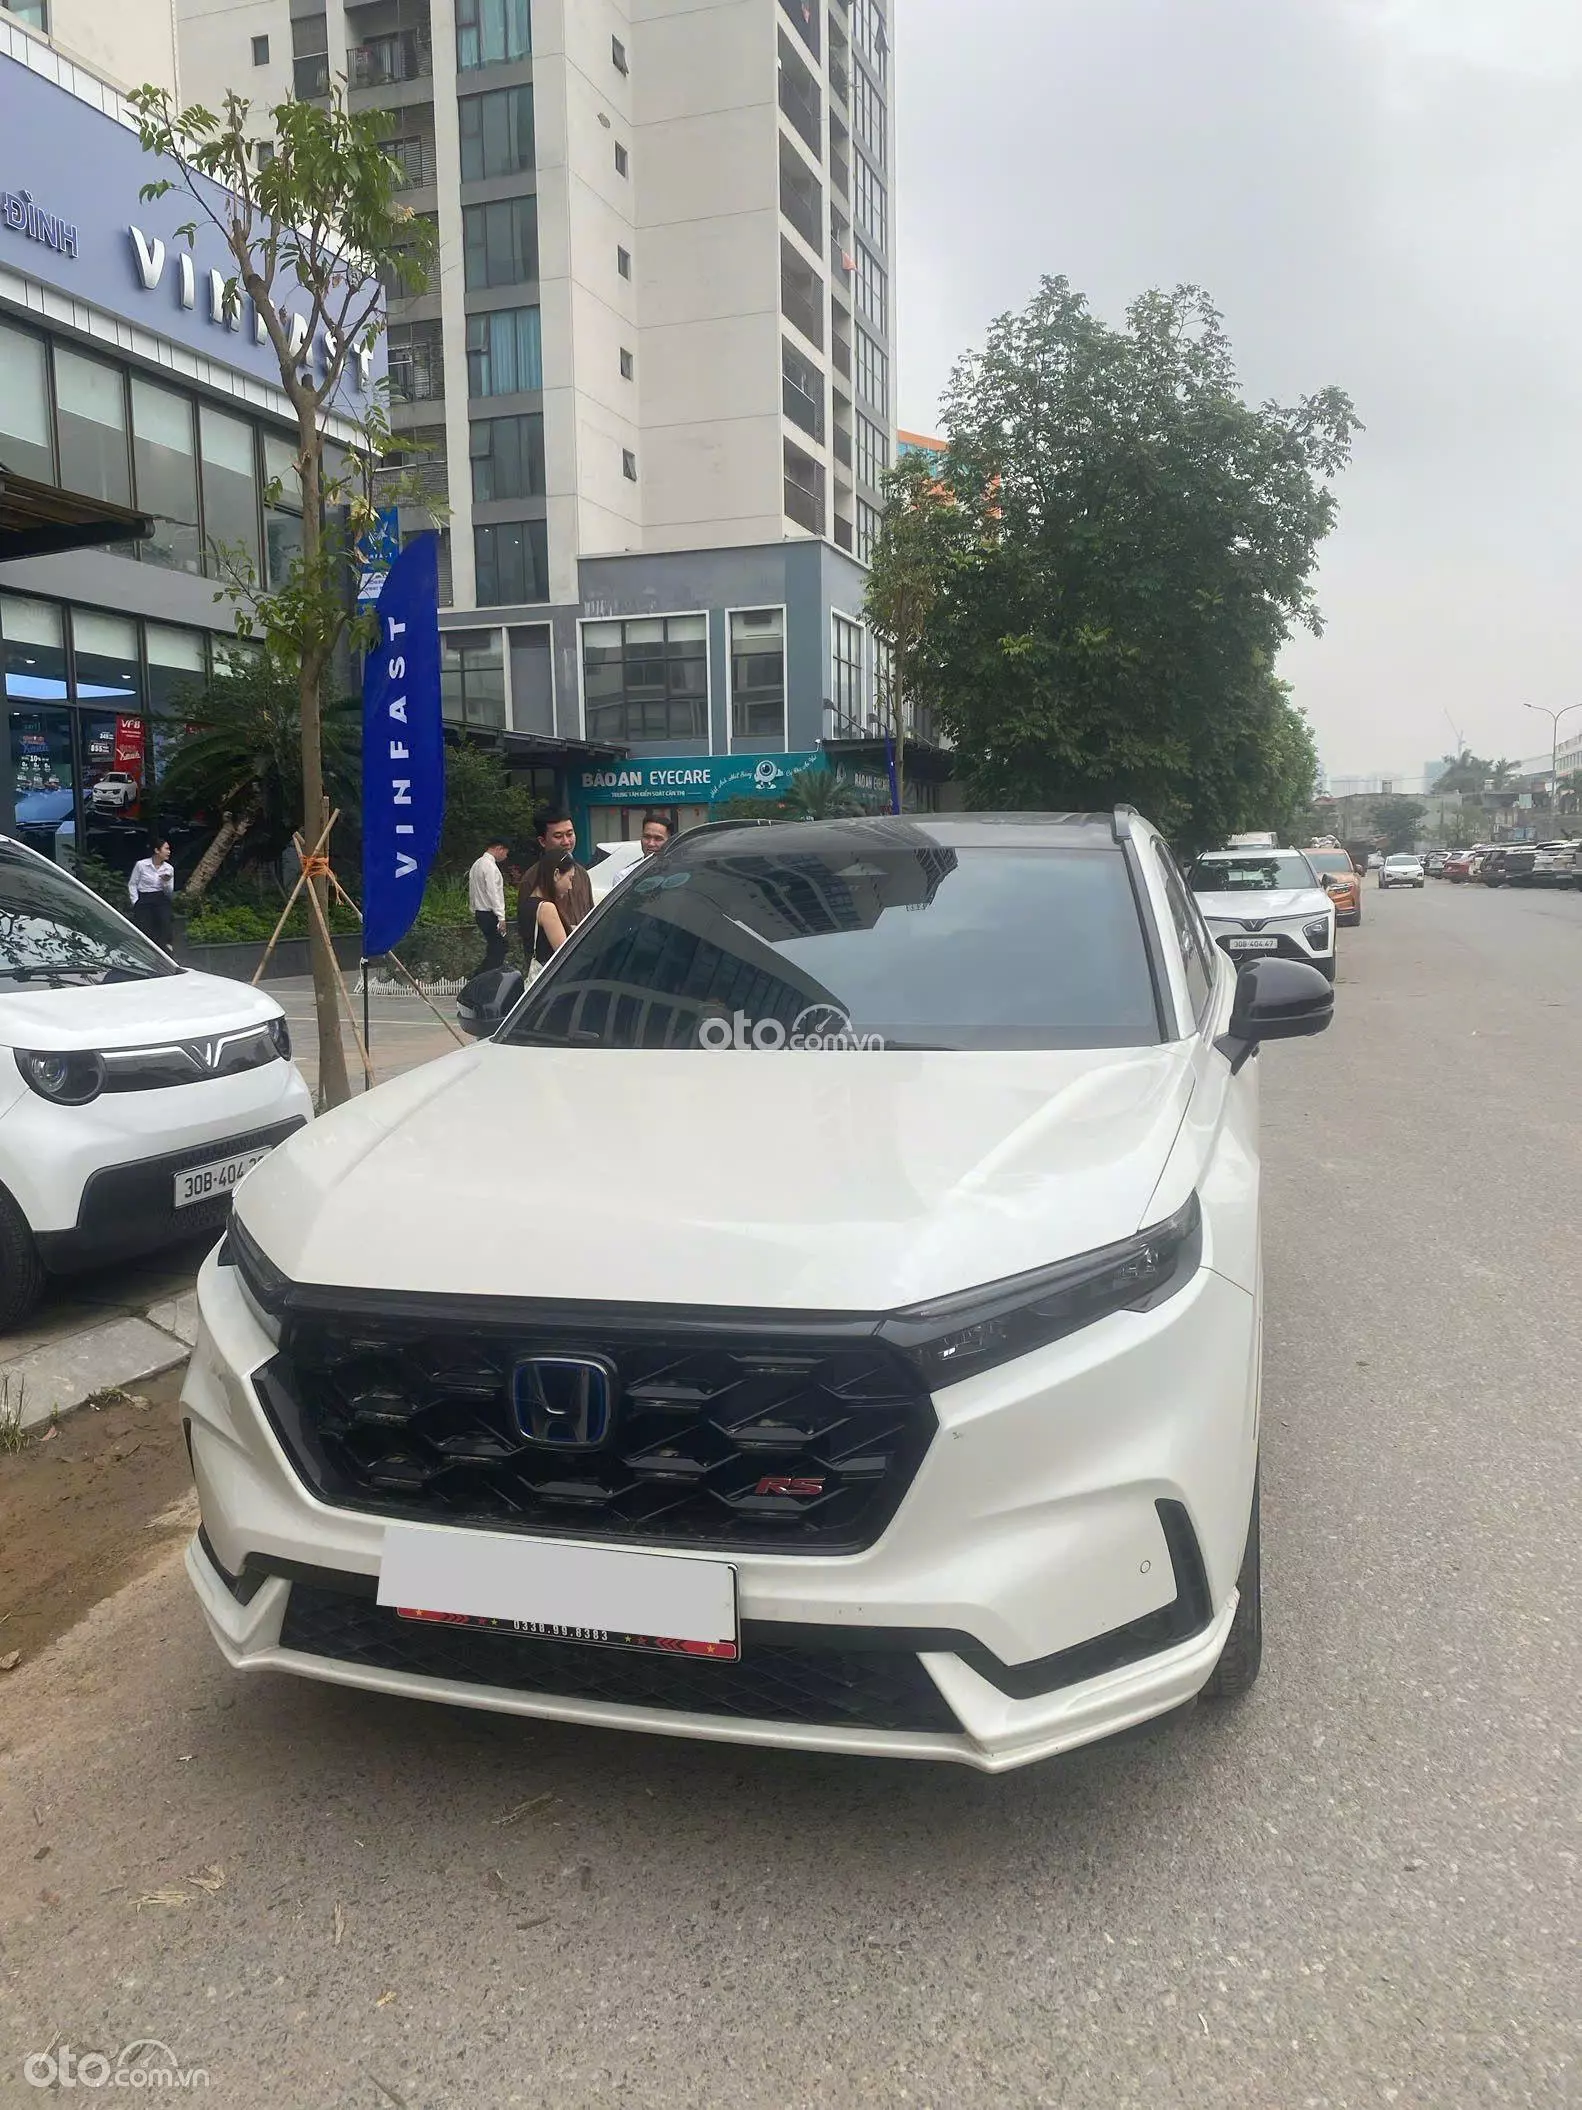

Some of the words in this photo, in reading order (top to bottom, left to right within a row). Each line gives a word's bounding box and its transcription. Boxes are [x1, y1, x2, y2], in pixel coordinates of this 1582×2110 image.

[4, 189, 79, 258] ĐÌNH
[388, 616, 418, 878] VINFAST
[649, 769, 711, 785] EYECARE
[754, 1477, 826, 1495] RS
[513, 1619, 609, 1641] 0338.99.8383
